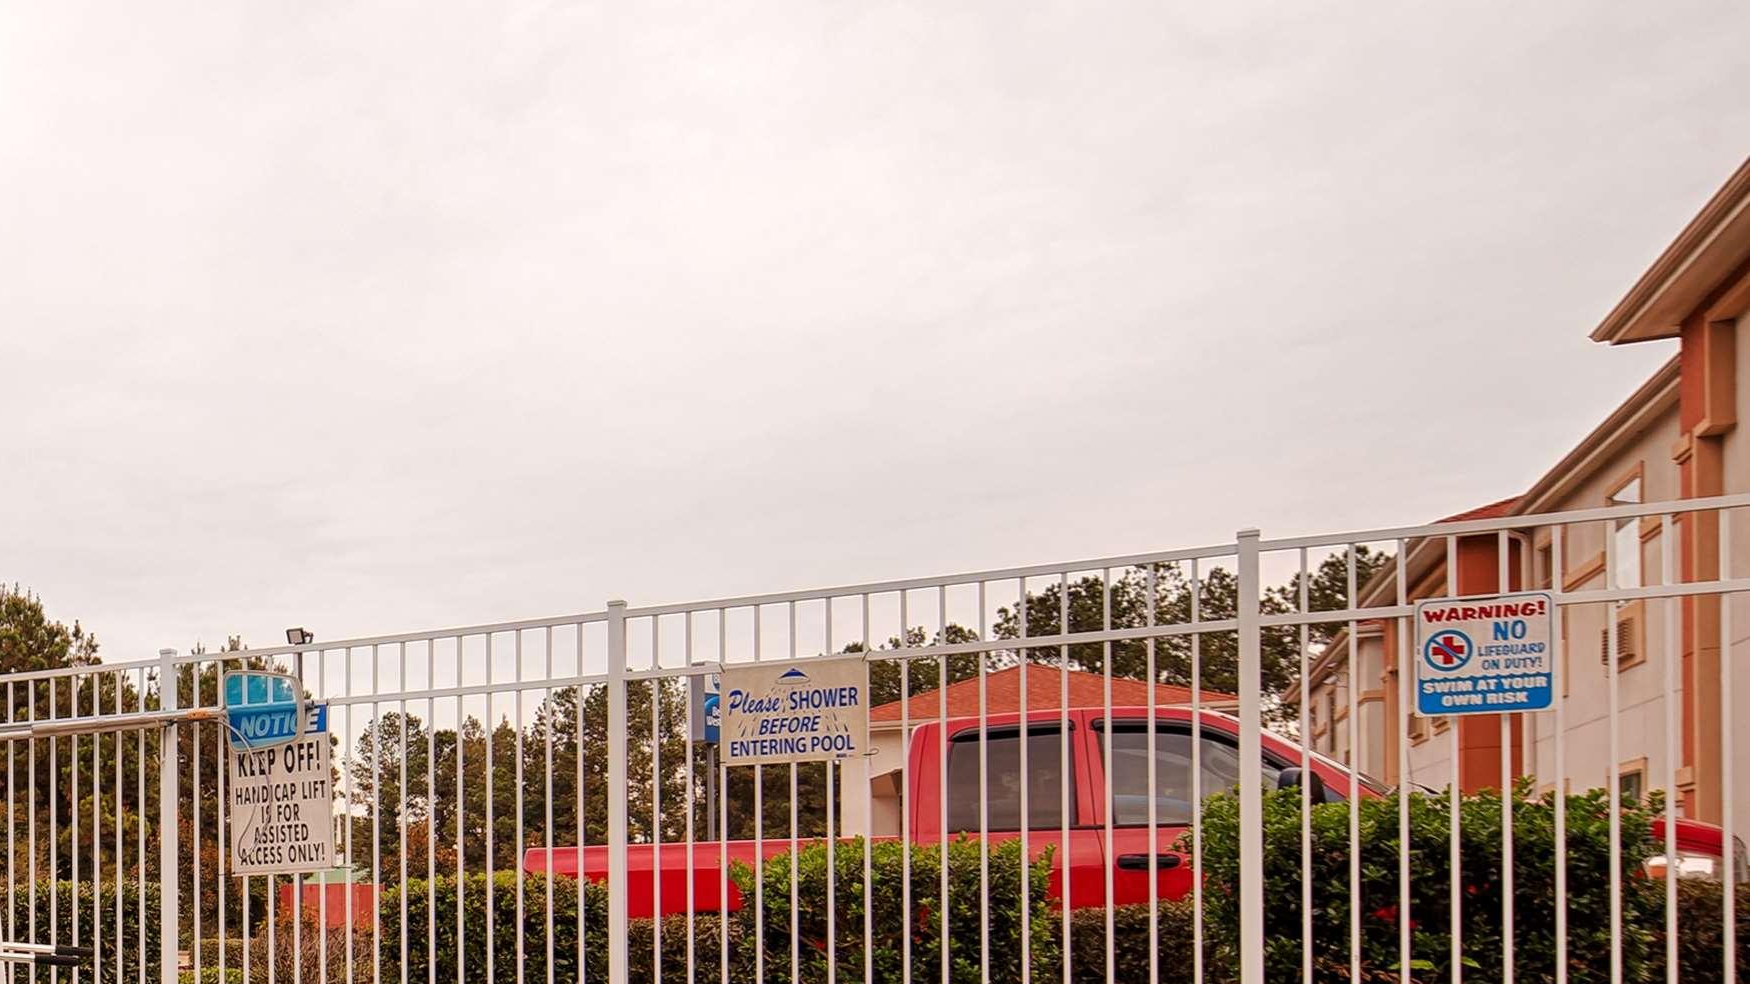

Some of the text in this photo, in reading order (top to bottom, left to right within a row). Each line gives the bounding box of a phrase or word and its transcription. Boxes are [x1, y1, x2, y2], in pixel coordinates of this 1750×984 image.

[1423, 600, 1546, 623] WARNING!
[1493, 619, 1527, 641] NO
[1477, 642, 1546, 657] LIFEGUARD
[1481, 657, 1543, 670] ON DUTY!
[1423, 676, 1548, 694] SWIM AT YOUR
[728, 689, 780, 716] Please
[789, 687, 858, 711] SHOWER
[1441, 691, 1529, 707] OWN RISK
[758, 715, 821, 736] BEFORE
[730, 734, 855, 758] ENTERING POOL
[238, 740, 320, 777] KEEP OFF!
[235, 780, 326, 805] HANDICAP LIFT
[261, 803, 300, 824] IS FOR
[254, 823, 309, 844] ASSISTED
[240, 842, 325, 866] ACCESS ONLY!
